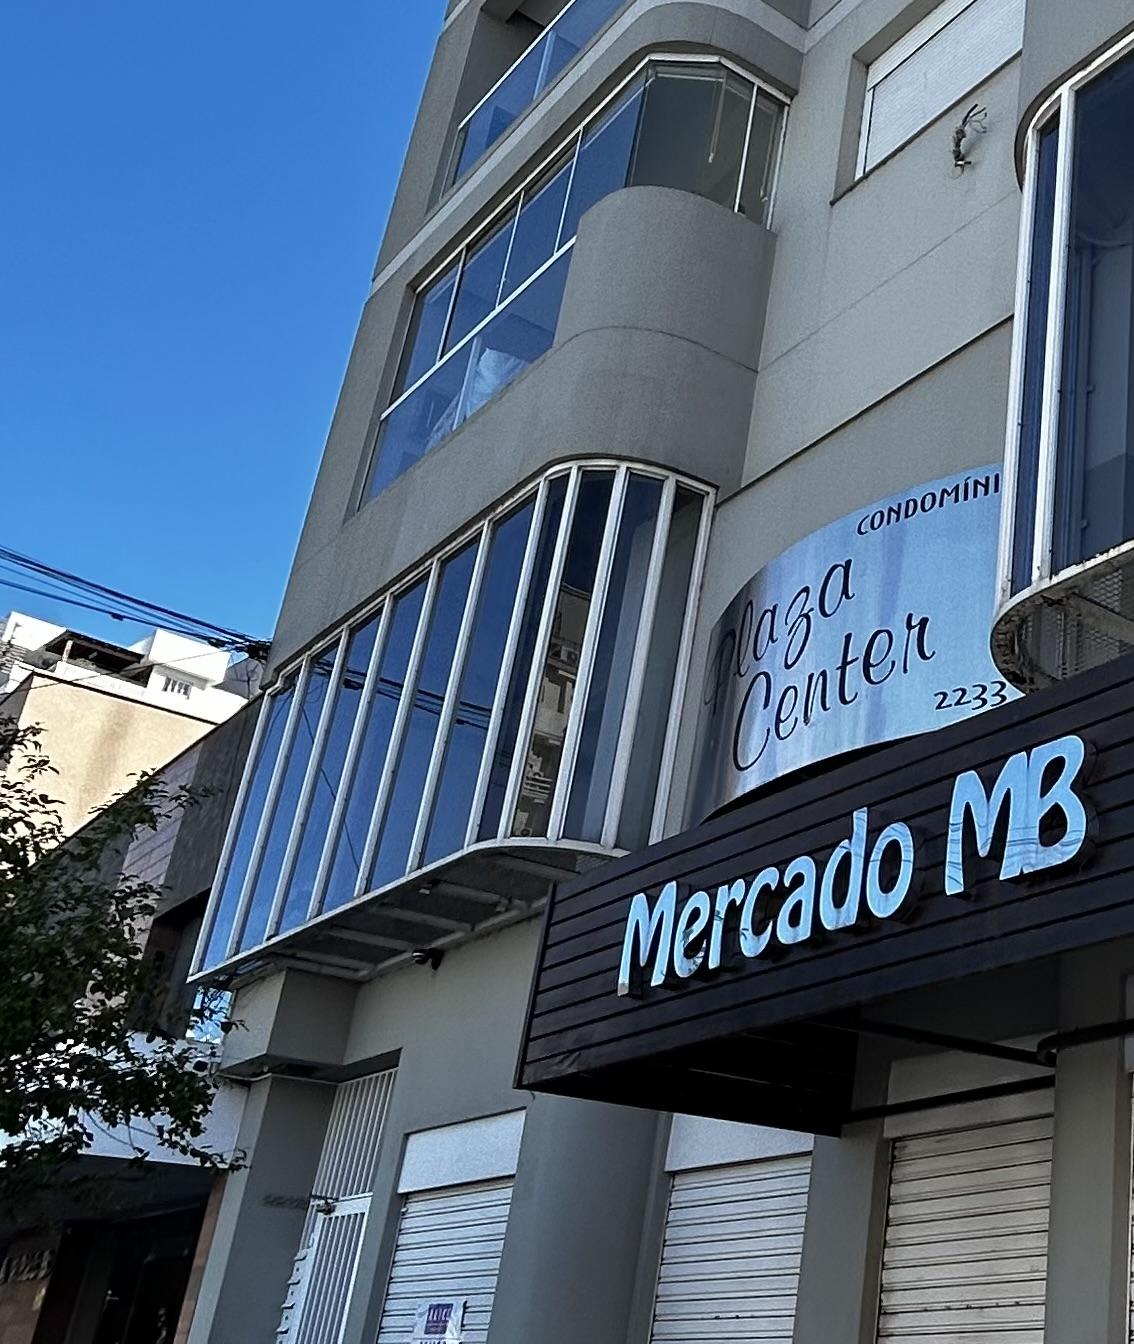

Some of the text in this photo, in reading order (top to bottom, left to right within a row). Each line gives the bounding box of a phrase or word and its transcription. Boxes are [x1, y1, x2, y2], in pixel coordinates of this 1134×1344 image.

[857, 472, 1001, 536] CONDOMÍNI
[703, 557, 856, 716] Plaza
[732, 612, 936, 772] Center
[934, 679, 1008, 711] 2233
[616, 734, 1090, 997] Mercado MB
